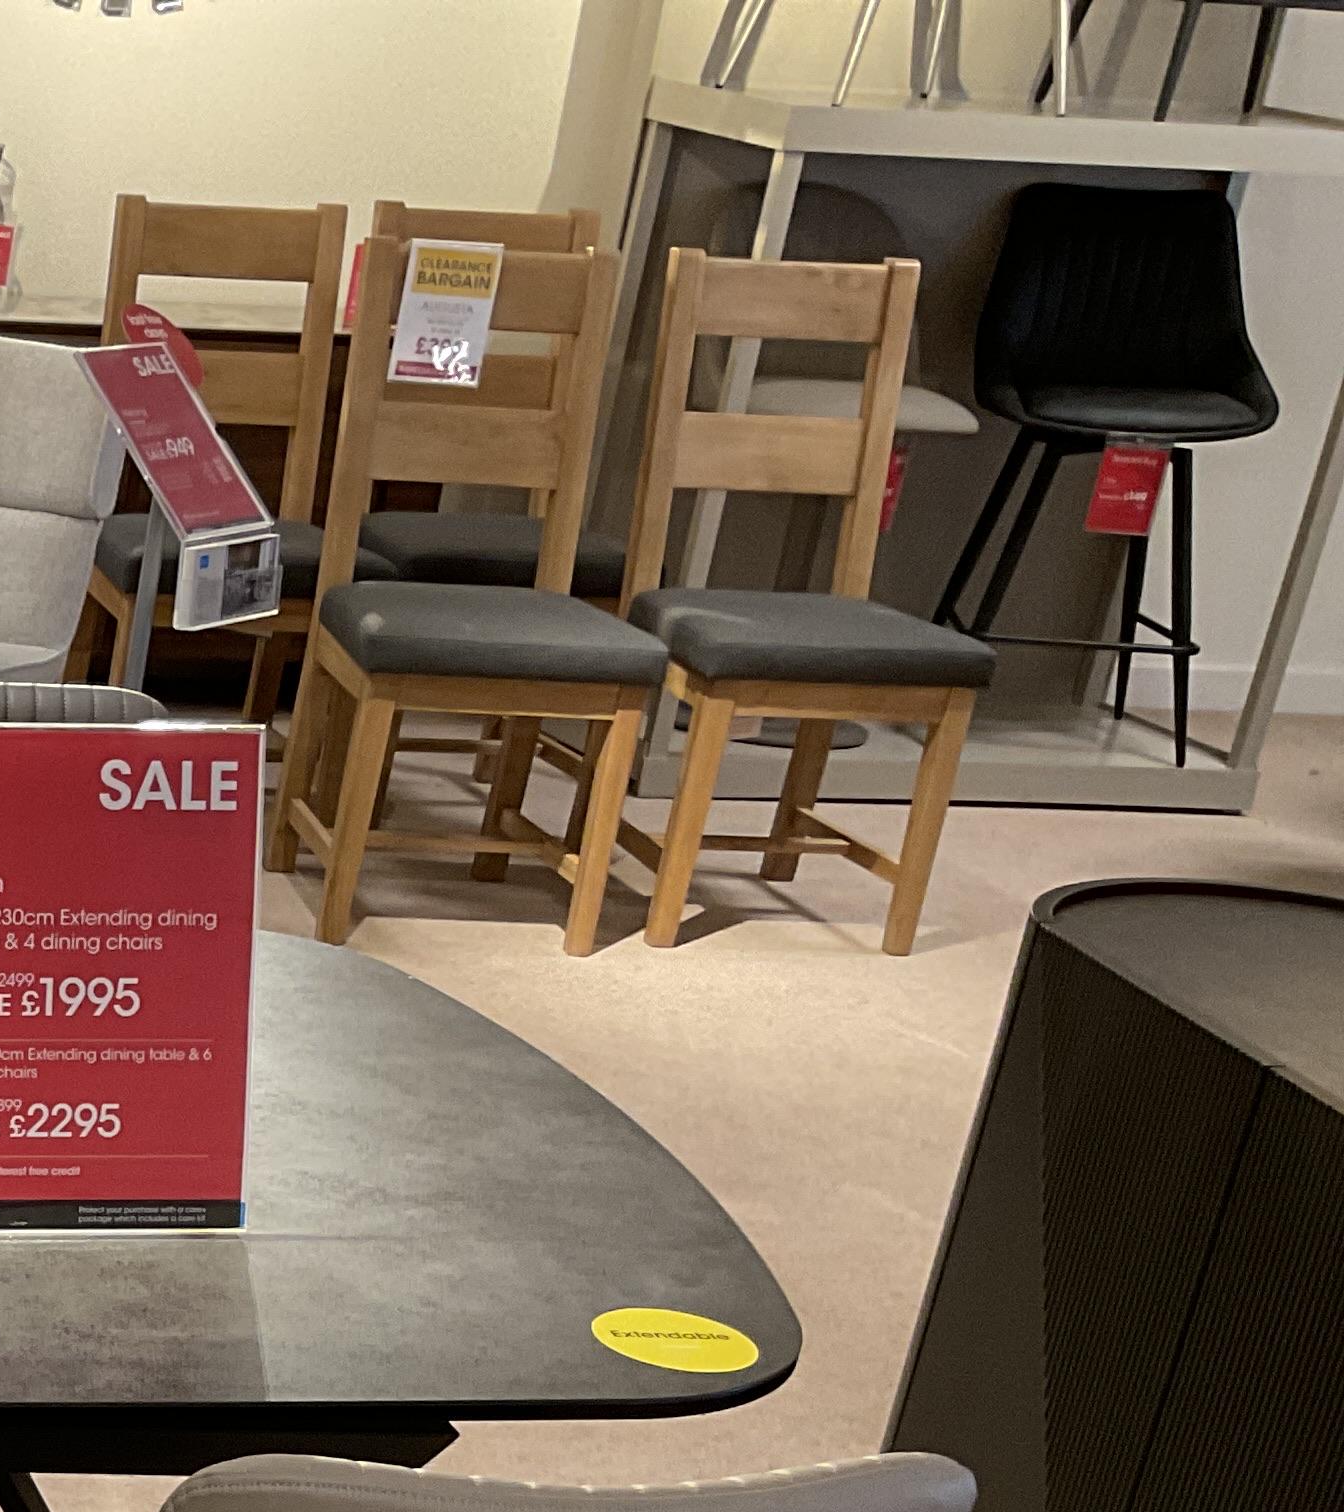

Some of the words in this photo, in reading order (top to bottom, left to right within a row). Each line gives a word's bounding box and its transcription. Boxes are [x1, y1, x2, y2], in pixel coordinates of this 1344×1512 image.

[419, 257, 492, 273] CLEARANCE
[416, 271, 491, 290] BARGAIN
[132, 353, 177, 377] SALE
[98, 758, 239, 812] SALE
[60, 908, 153, 930] Extending
[158, 908, 218, 930] dining
[4, 932, 18, 950] &
[23, 932, 35, 950] 4
[41, 932, 101, 954] dining
[106, 932, 163, 951] chairs
[21, 976, 141, 1018] £1995
[28, 1047, 97, 1064] Extending
[100, 1047, 145, 1064] dining
[149, 1047, 184, 1061] table
[188, 1047, 200, 1061] &
[203, 1047, 212, 1061] 6
[9, 1103, 122, 1138] £2295
[609, 1329, 730, 1341] Extendable
